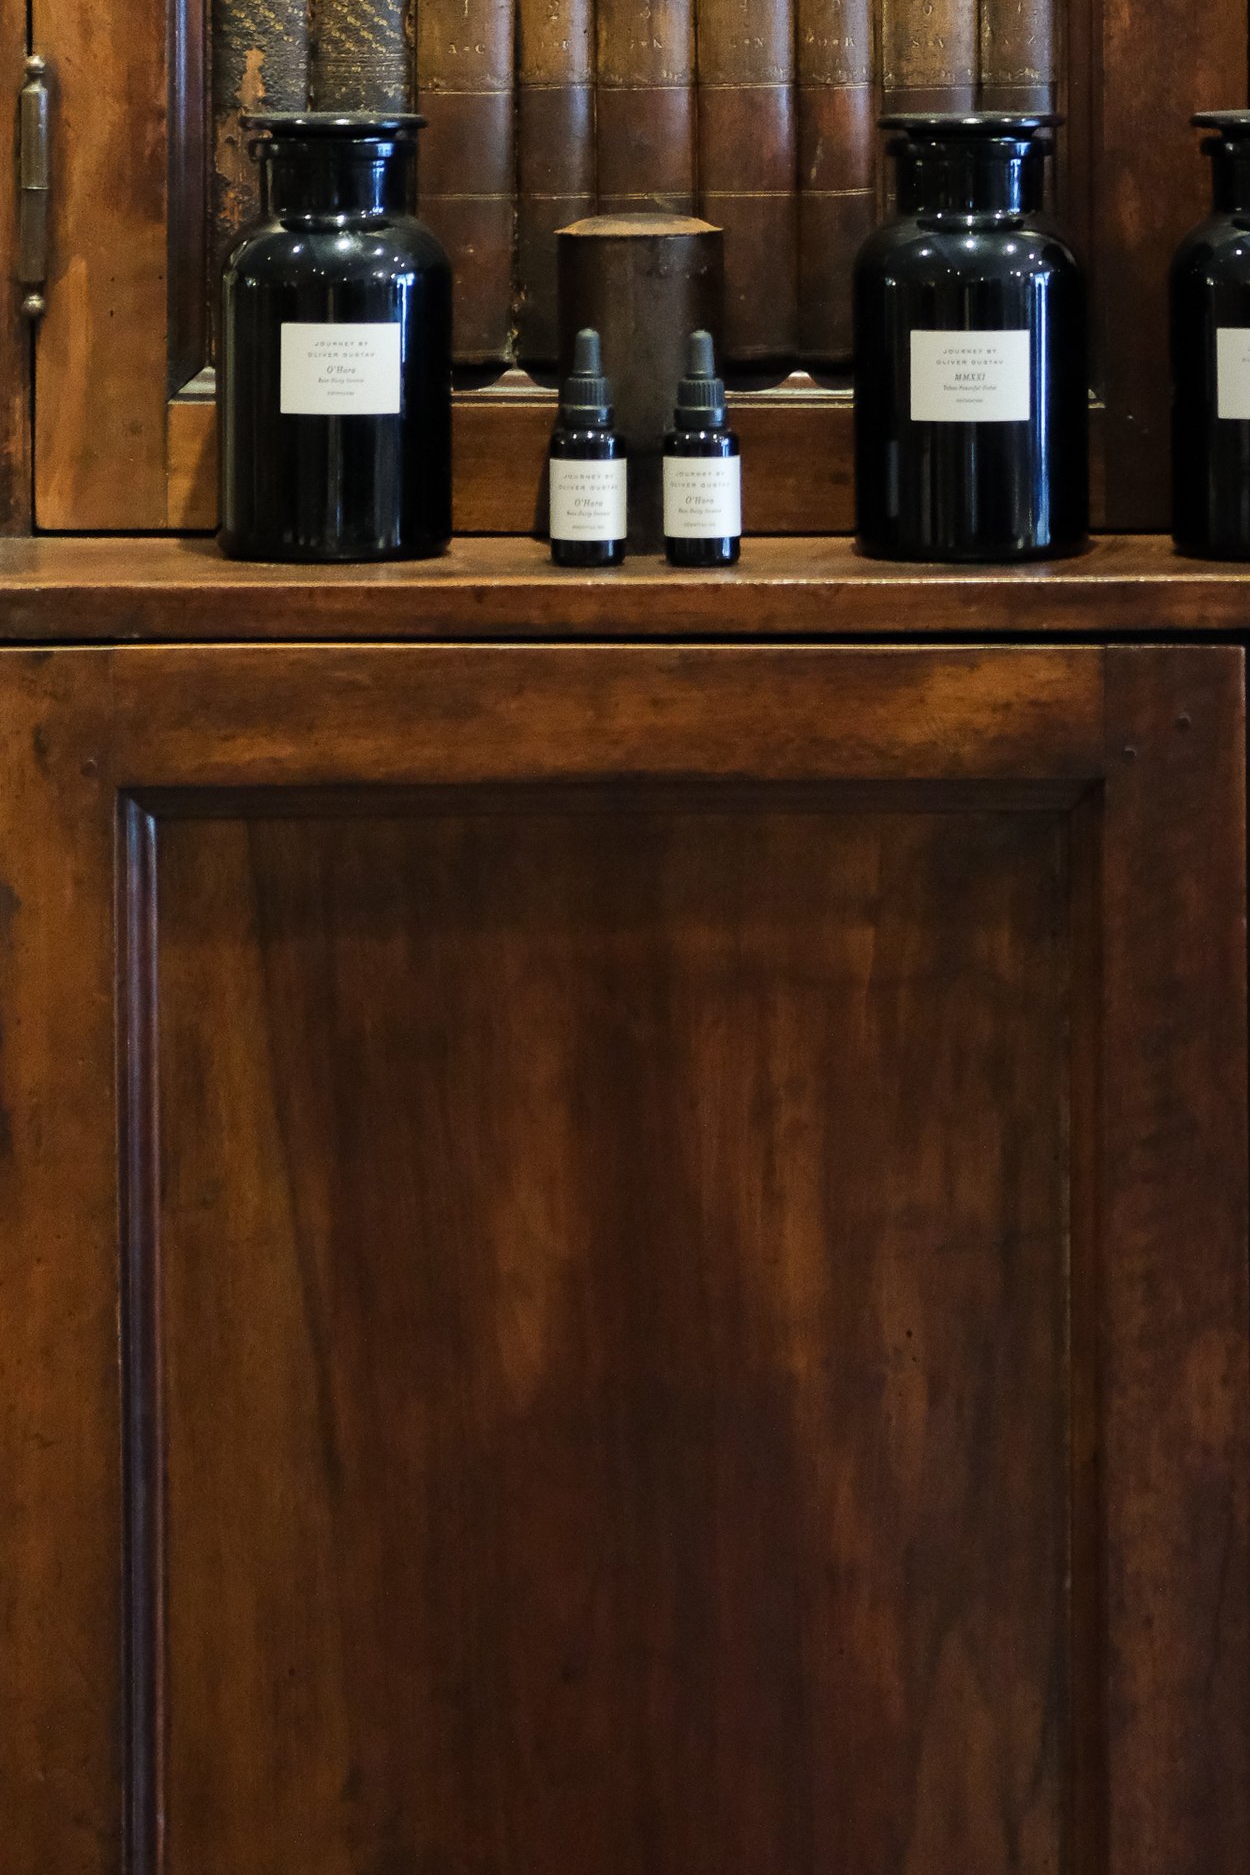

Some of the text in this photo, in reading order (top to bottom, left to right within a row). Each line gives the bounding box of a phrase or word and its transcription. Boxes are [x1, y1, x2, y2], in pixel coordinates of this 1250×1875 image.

[313, 340, 355, 348] JOURNEY
[325, 364, 357, 375] O'Hara
[953, 372, 987, 382] MMXXI
[684, 494, 715, 505] O'Hara
